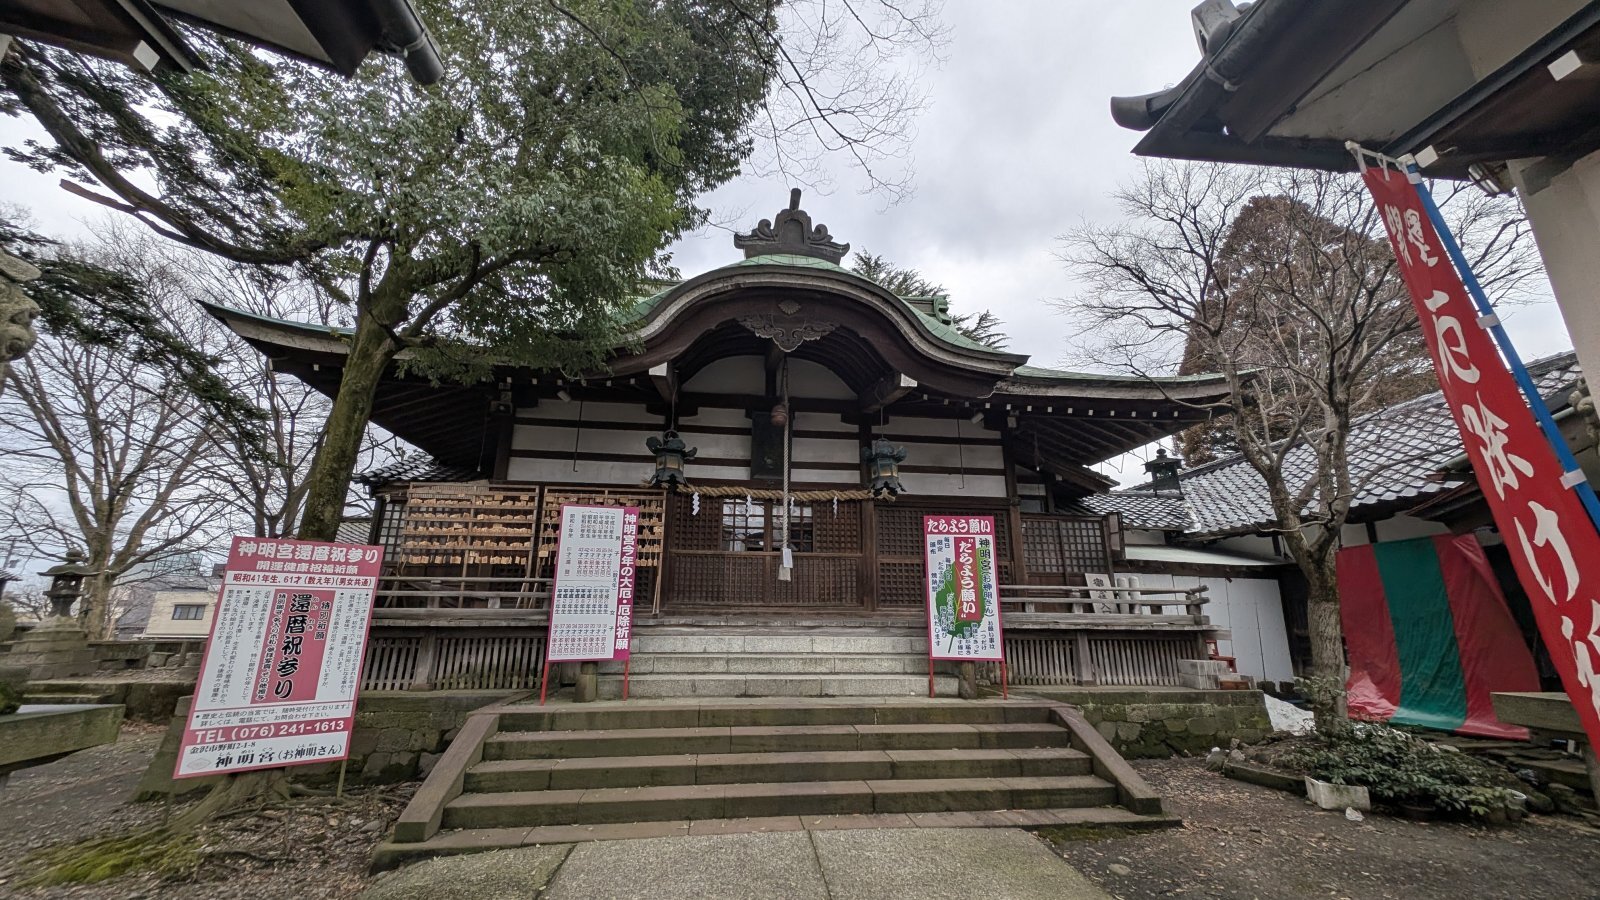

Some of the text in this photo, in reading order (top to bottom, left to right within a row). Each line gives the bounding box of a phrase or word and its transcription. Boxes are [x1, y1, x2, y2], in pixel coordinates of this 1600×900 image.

[928, 518, 991, 533] たらよう願い
[238, 540, 378, 564] 神明宮還暦祝参り
[256, 561, 358, 575] 開運健康招福祈願
[615, 513, 637, 650] 神明宮今年の大厄・厄除祈願
[315, 601, 331, 640] 特別祈願
[275, 593, 313, 699] 還暦祝参り
[195, 720, 344, 744] TEL (076) 241-1613
[190, 742, 256, 755] 金沢市野町2-1-8
[216, 745, 342, 768] 神明宮 （お神明さん）
